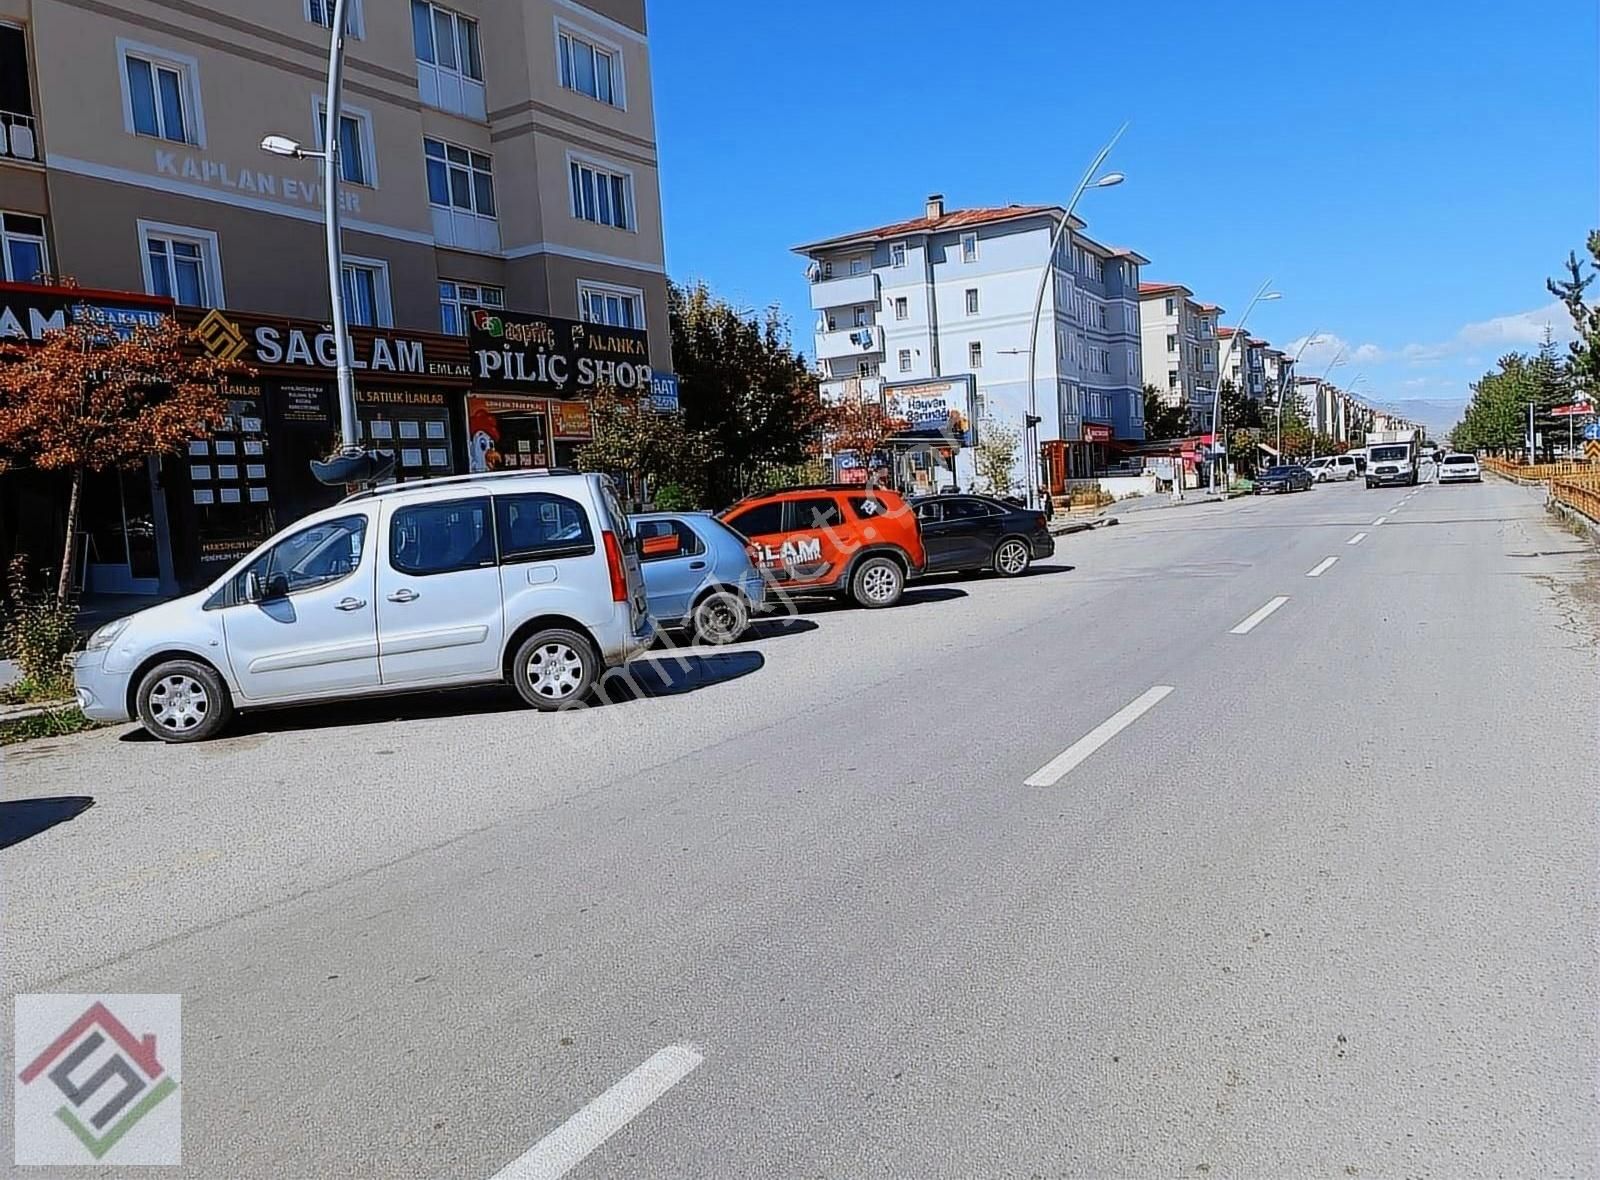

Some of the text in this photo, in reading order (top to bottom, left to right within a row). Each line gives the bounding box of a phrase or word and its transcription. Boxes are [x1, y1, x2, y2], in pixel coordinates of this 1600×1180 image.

[155, 149, 276, 195] KAPLAN
[255, 323, 471, 376] SAĞLAM EMLAK
[474, 343, 652, 390] PİLİÇ SHOP
[367, 390, 403, 402] SATILIK
[908, 398, 947, 412] Hayvan
